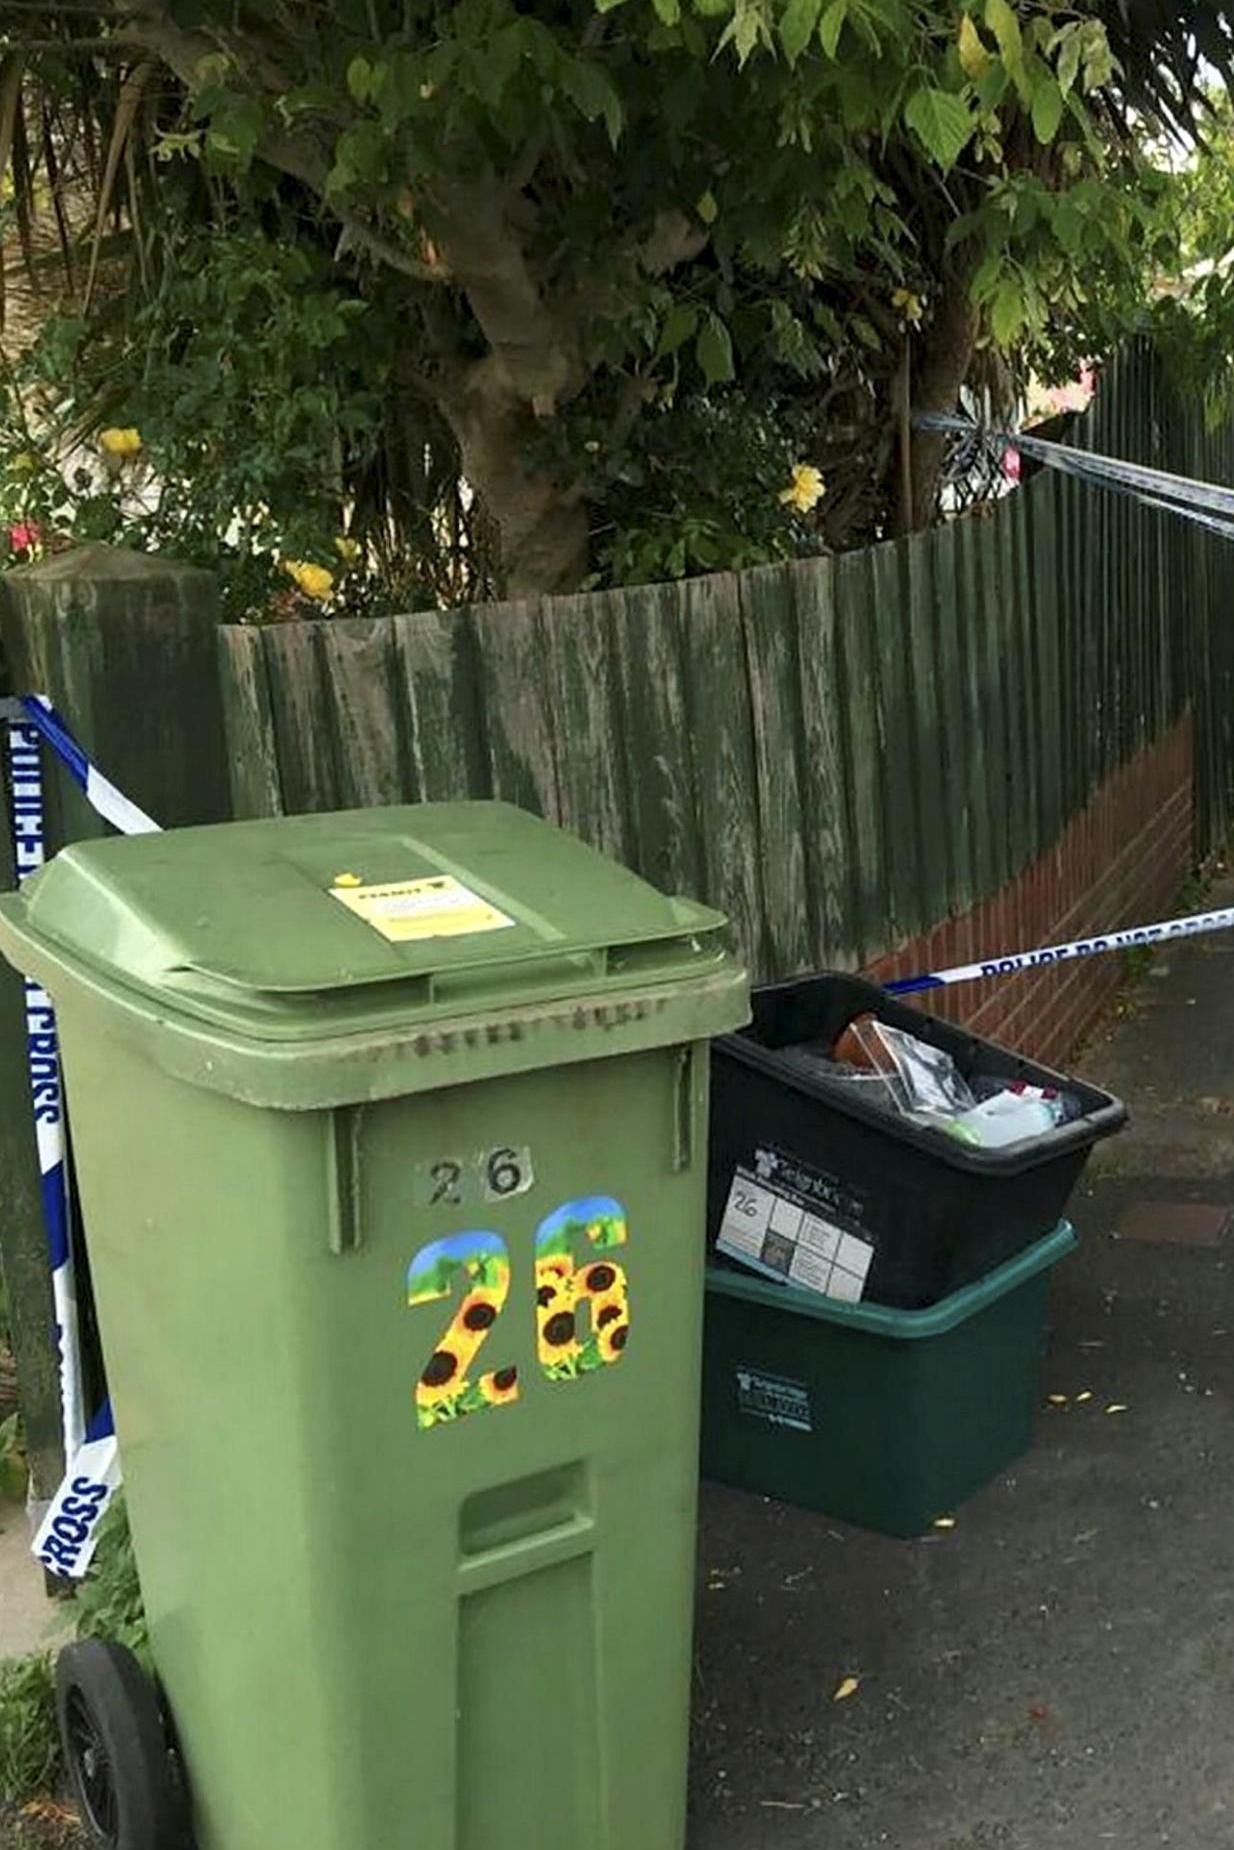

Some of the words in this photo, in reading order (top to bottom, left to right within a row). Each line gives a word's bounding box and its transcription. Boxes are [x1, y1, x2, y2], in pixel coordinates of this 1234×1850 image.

[26, 1006, 62, 1123] CROSS
[733, 1190, 758, 1217] 26
[407, 1195, 631, 1431] 26
